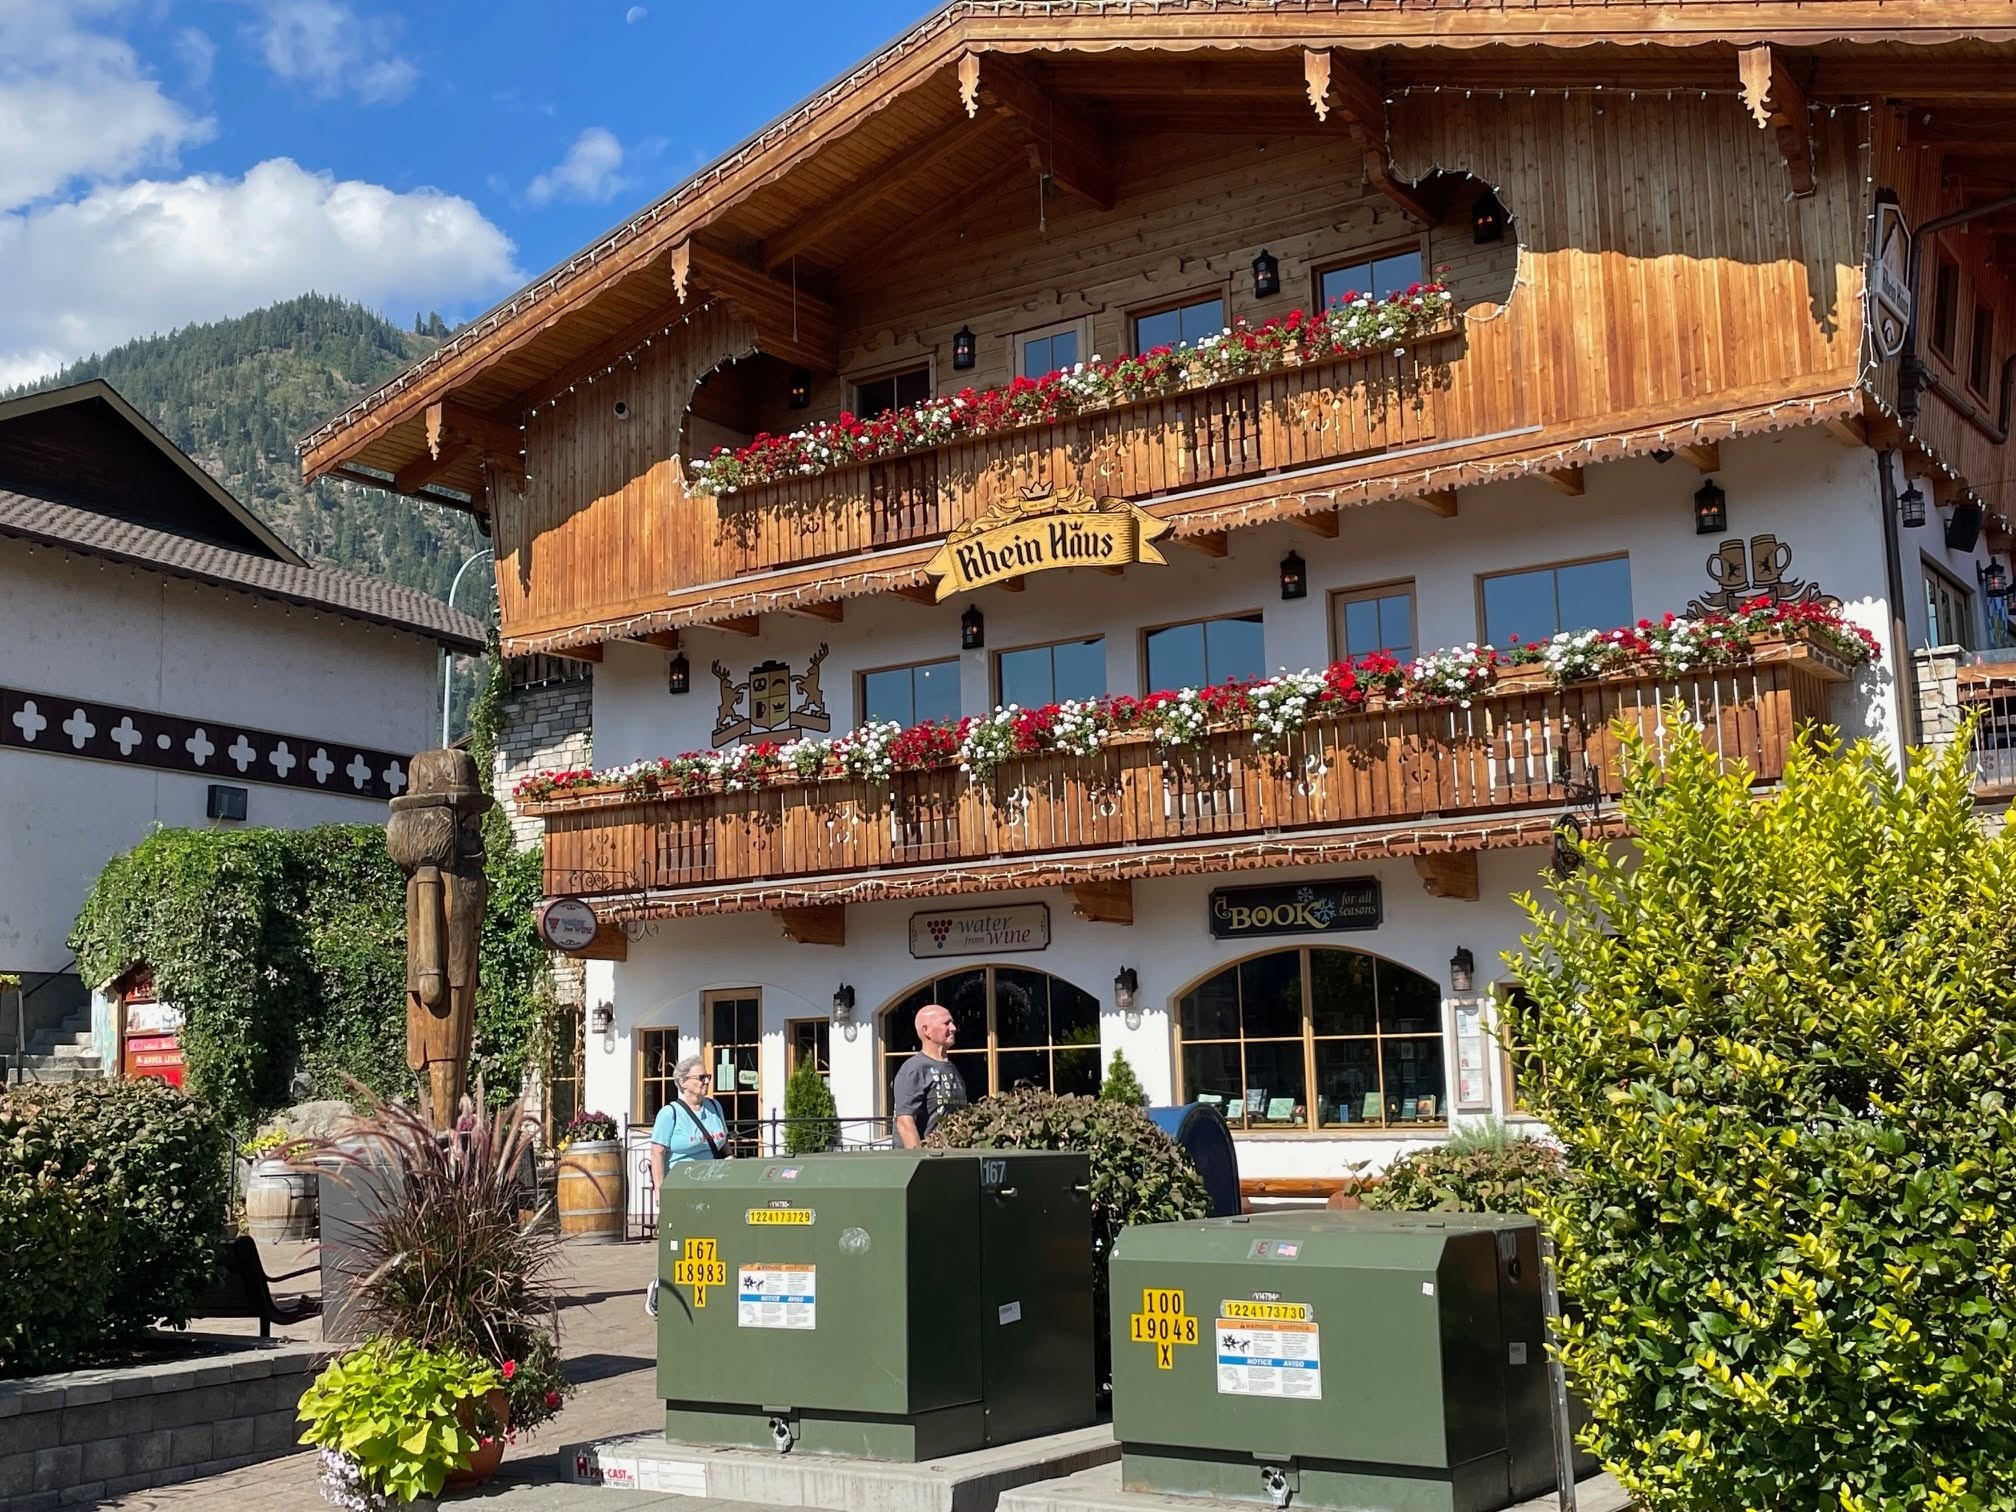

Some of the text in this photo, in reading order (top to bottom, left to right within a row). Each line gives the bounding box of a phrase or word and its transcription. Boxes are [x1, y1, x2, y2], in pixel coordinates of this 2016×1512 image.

[956, 534, 1043, 582] Rhein
[1341, 888, 1372, 906] for all
[1229, 901, 1330, 929] BOOK
[1338, 905, 1376, 917] seasons
[958, 915, 1013, 933] water
[965, 928, 1031, 946] from wine
[983, 1160, 1006, 1184] 167
[751, 1211, 810, 1222] 1224173729
[688, 1241, 714, 1260] 167
[1500, 1231, 1516, 1259] 100
[678, 1263, 724, 1282] 18983
[697, 1286, 703, 1304] X
[1147, 1292, 1181, 1314] 100
[1227, 1303, 1306, 1319] 1224173730
[1135, 1317, 1195, 1341] 19048
[1161, 1344, 1170, 1366] X
[1247, 1357, 1273, 1366] NOTICE
